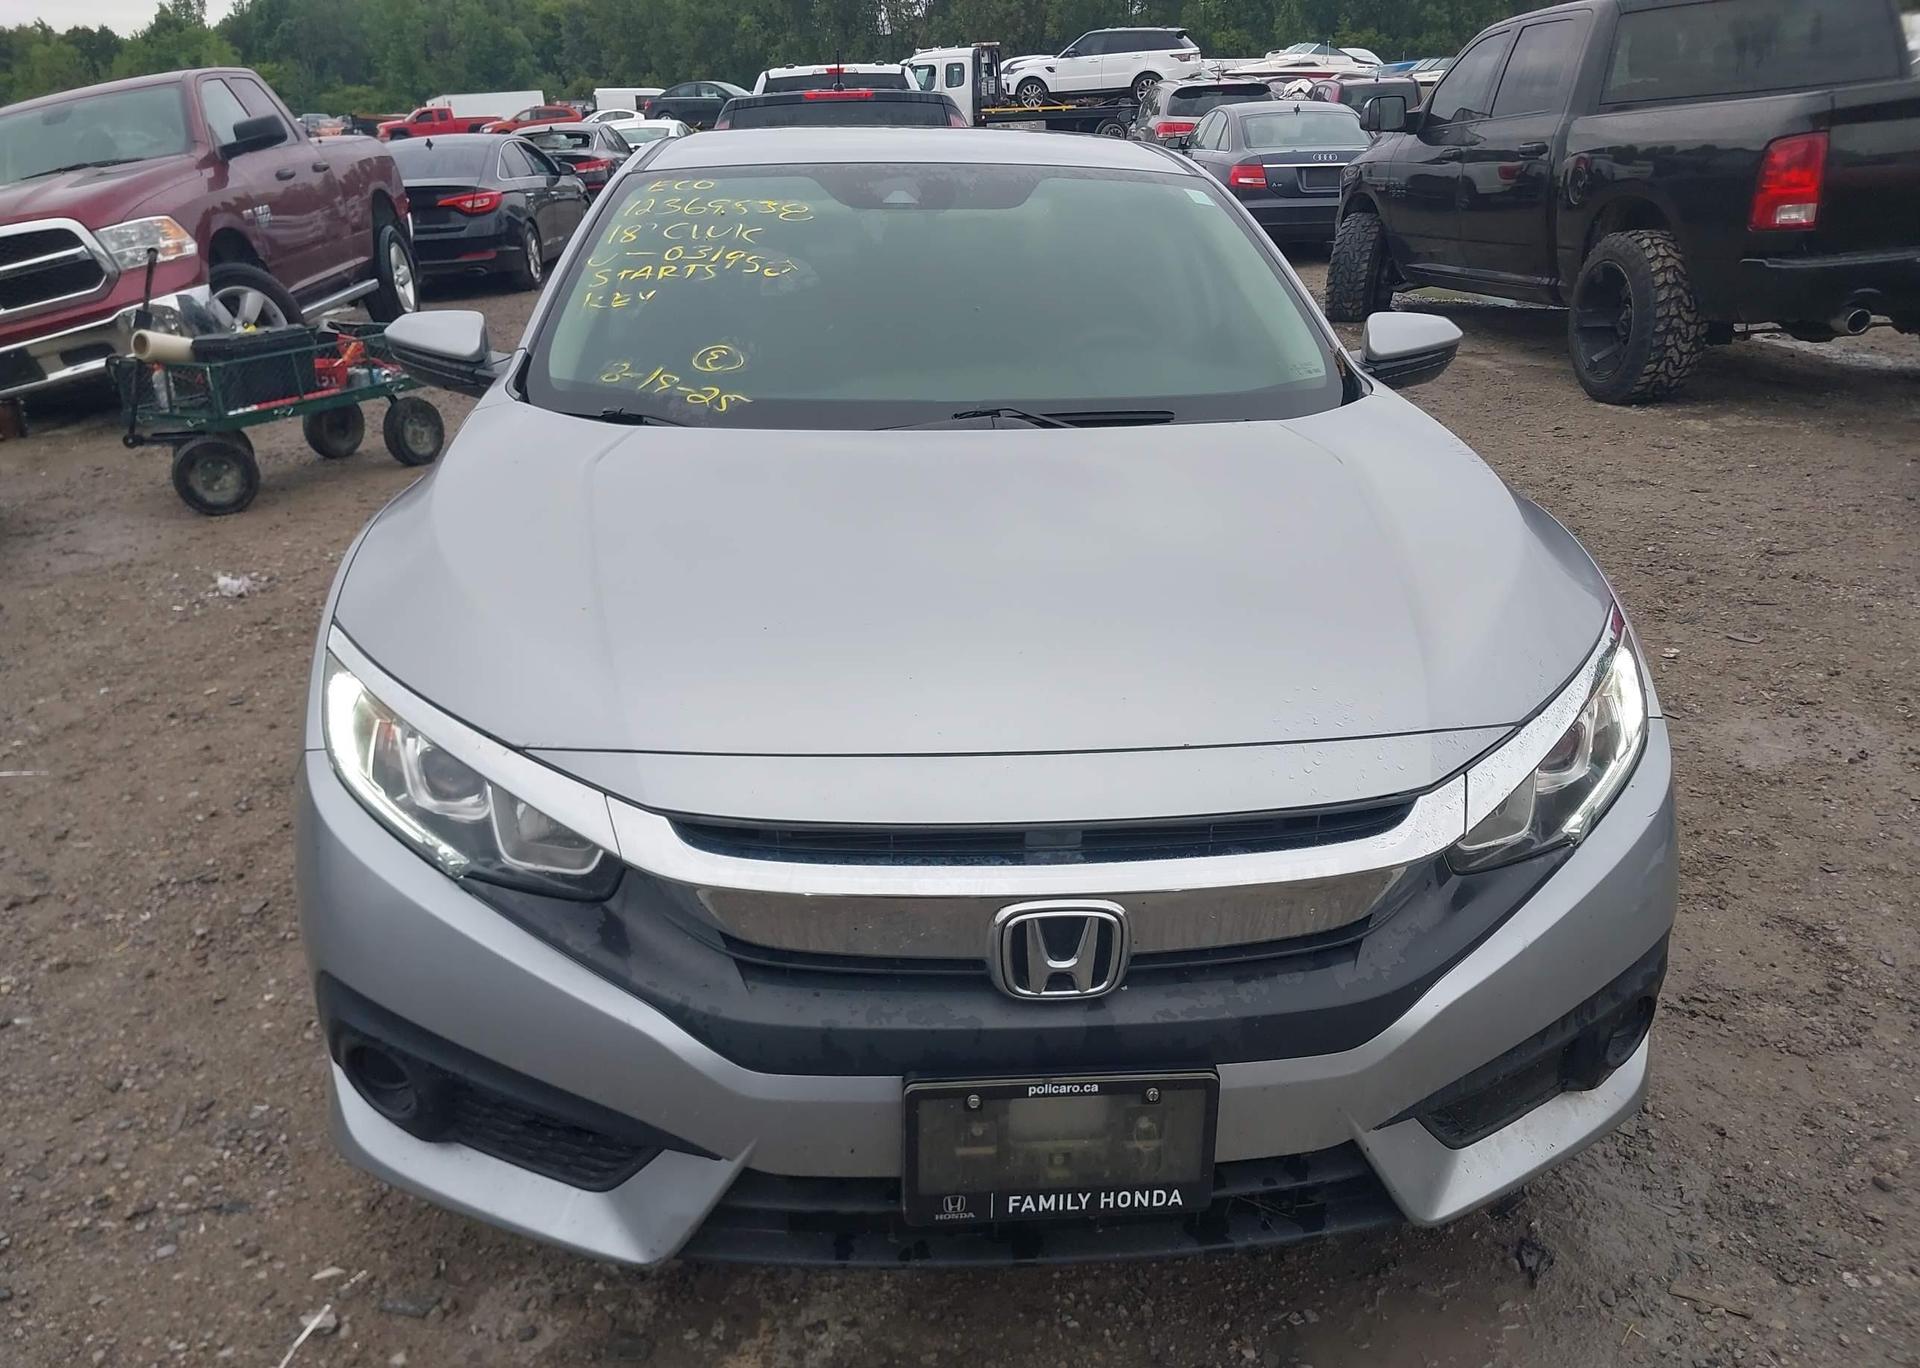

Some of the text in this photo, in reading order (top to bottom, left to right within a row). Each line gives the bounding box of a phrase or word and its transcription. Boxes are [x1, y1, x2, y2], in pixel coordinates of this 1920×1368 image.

[647, 179, 715, 192] ECO
[588, 264, 717, 288] STARTS
[1027, 1082, 1099, 1098] policaro.ca
[1008, 1188, 1184, 1214] FAMILY HONDA
[935, 1211, 976, 1220] HONDA
